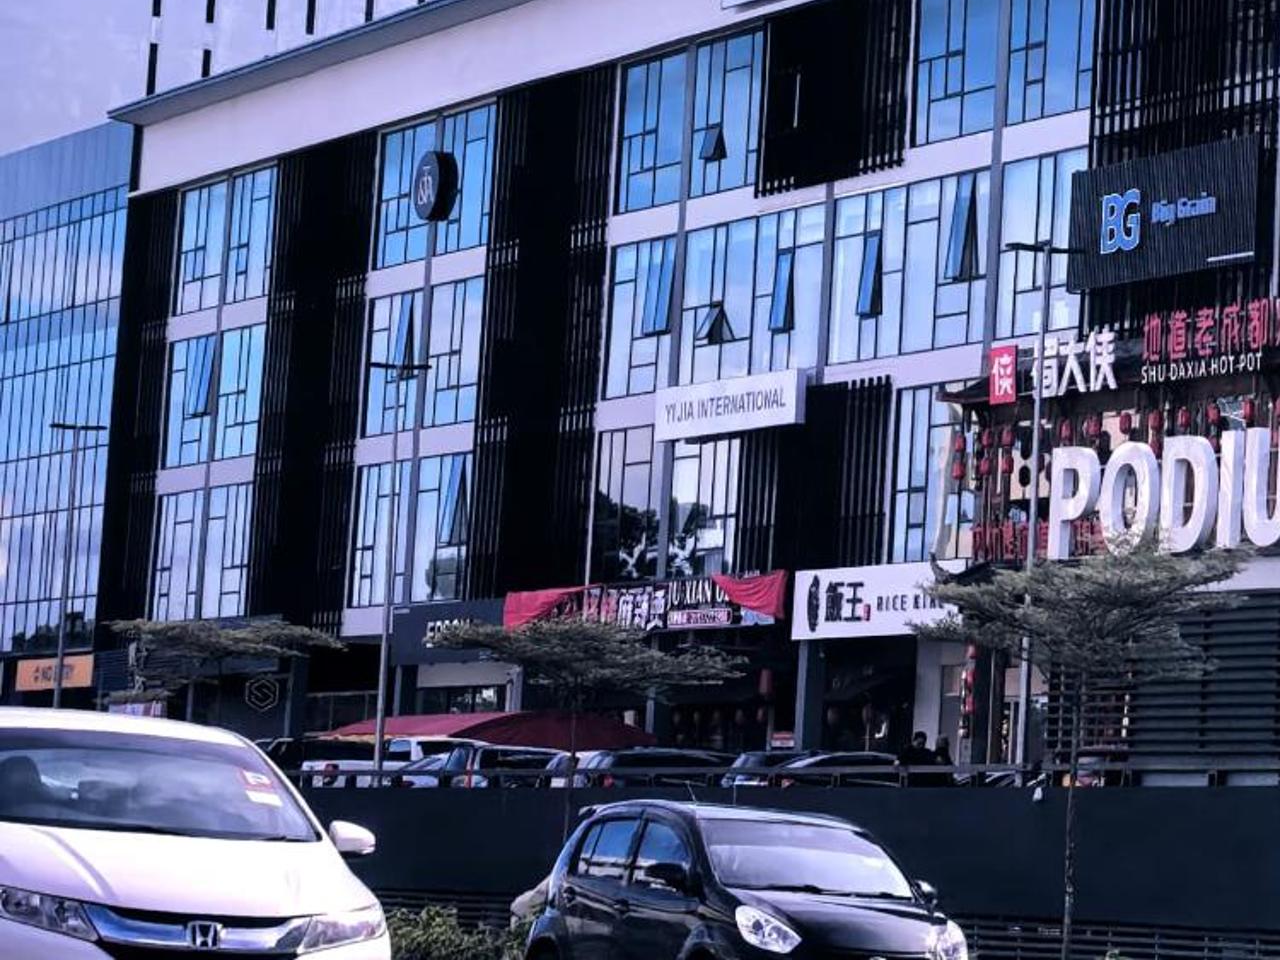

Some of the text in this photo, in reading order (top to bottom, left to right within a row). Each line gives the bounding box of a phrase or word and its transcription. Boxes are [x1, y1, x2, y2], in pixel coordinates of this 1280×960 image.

[1100, 188, 1141, 254] BG
[1141, 352, 1263, 385] SHU DAXIA HOT POT
[697, 388, 786, 420] INTERNATIONAL
[876, 594, 908, 612] RICE
